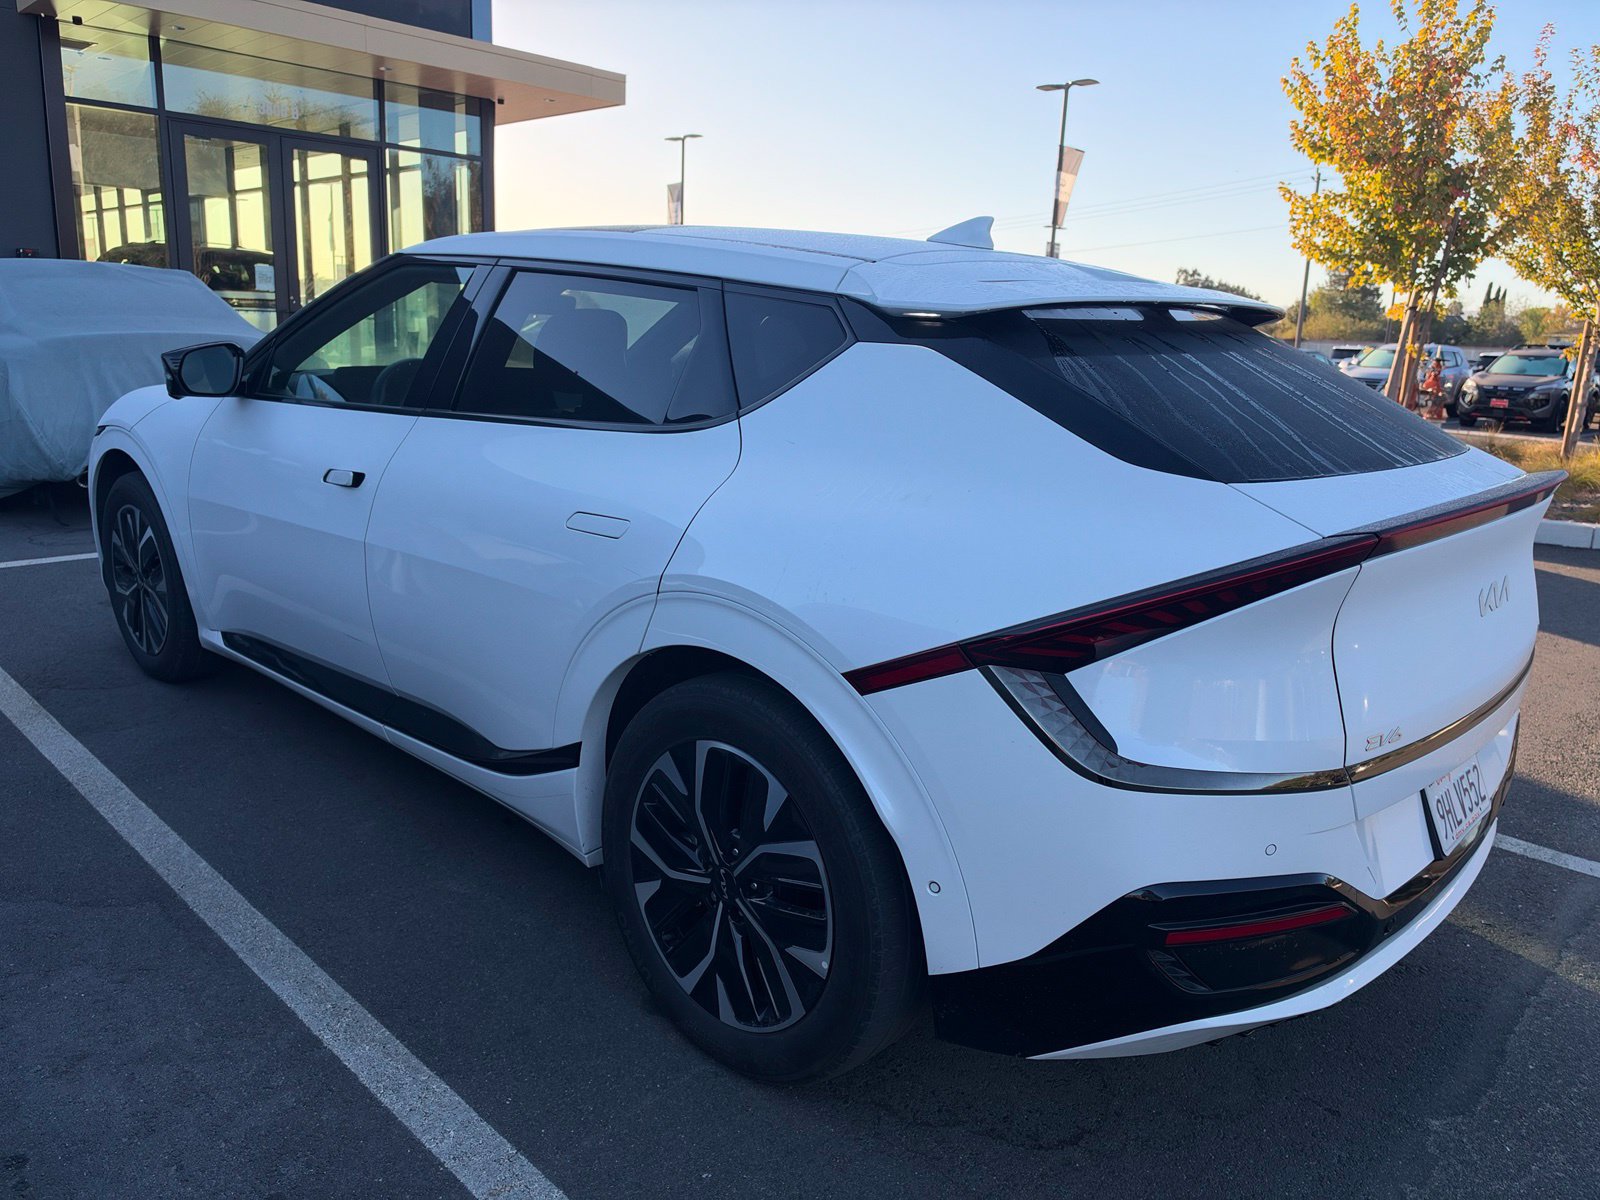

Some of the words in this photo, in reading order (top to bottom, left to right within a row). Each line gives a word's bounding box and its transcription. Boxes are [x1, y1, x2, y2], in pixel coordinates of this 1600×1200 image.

[1478, 575, 1510, 618] KIA
[1365, 726, 1403, 752] EV6
[1436, 764, 1487, 841] 9HLV552
